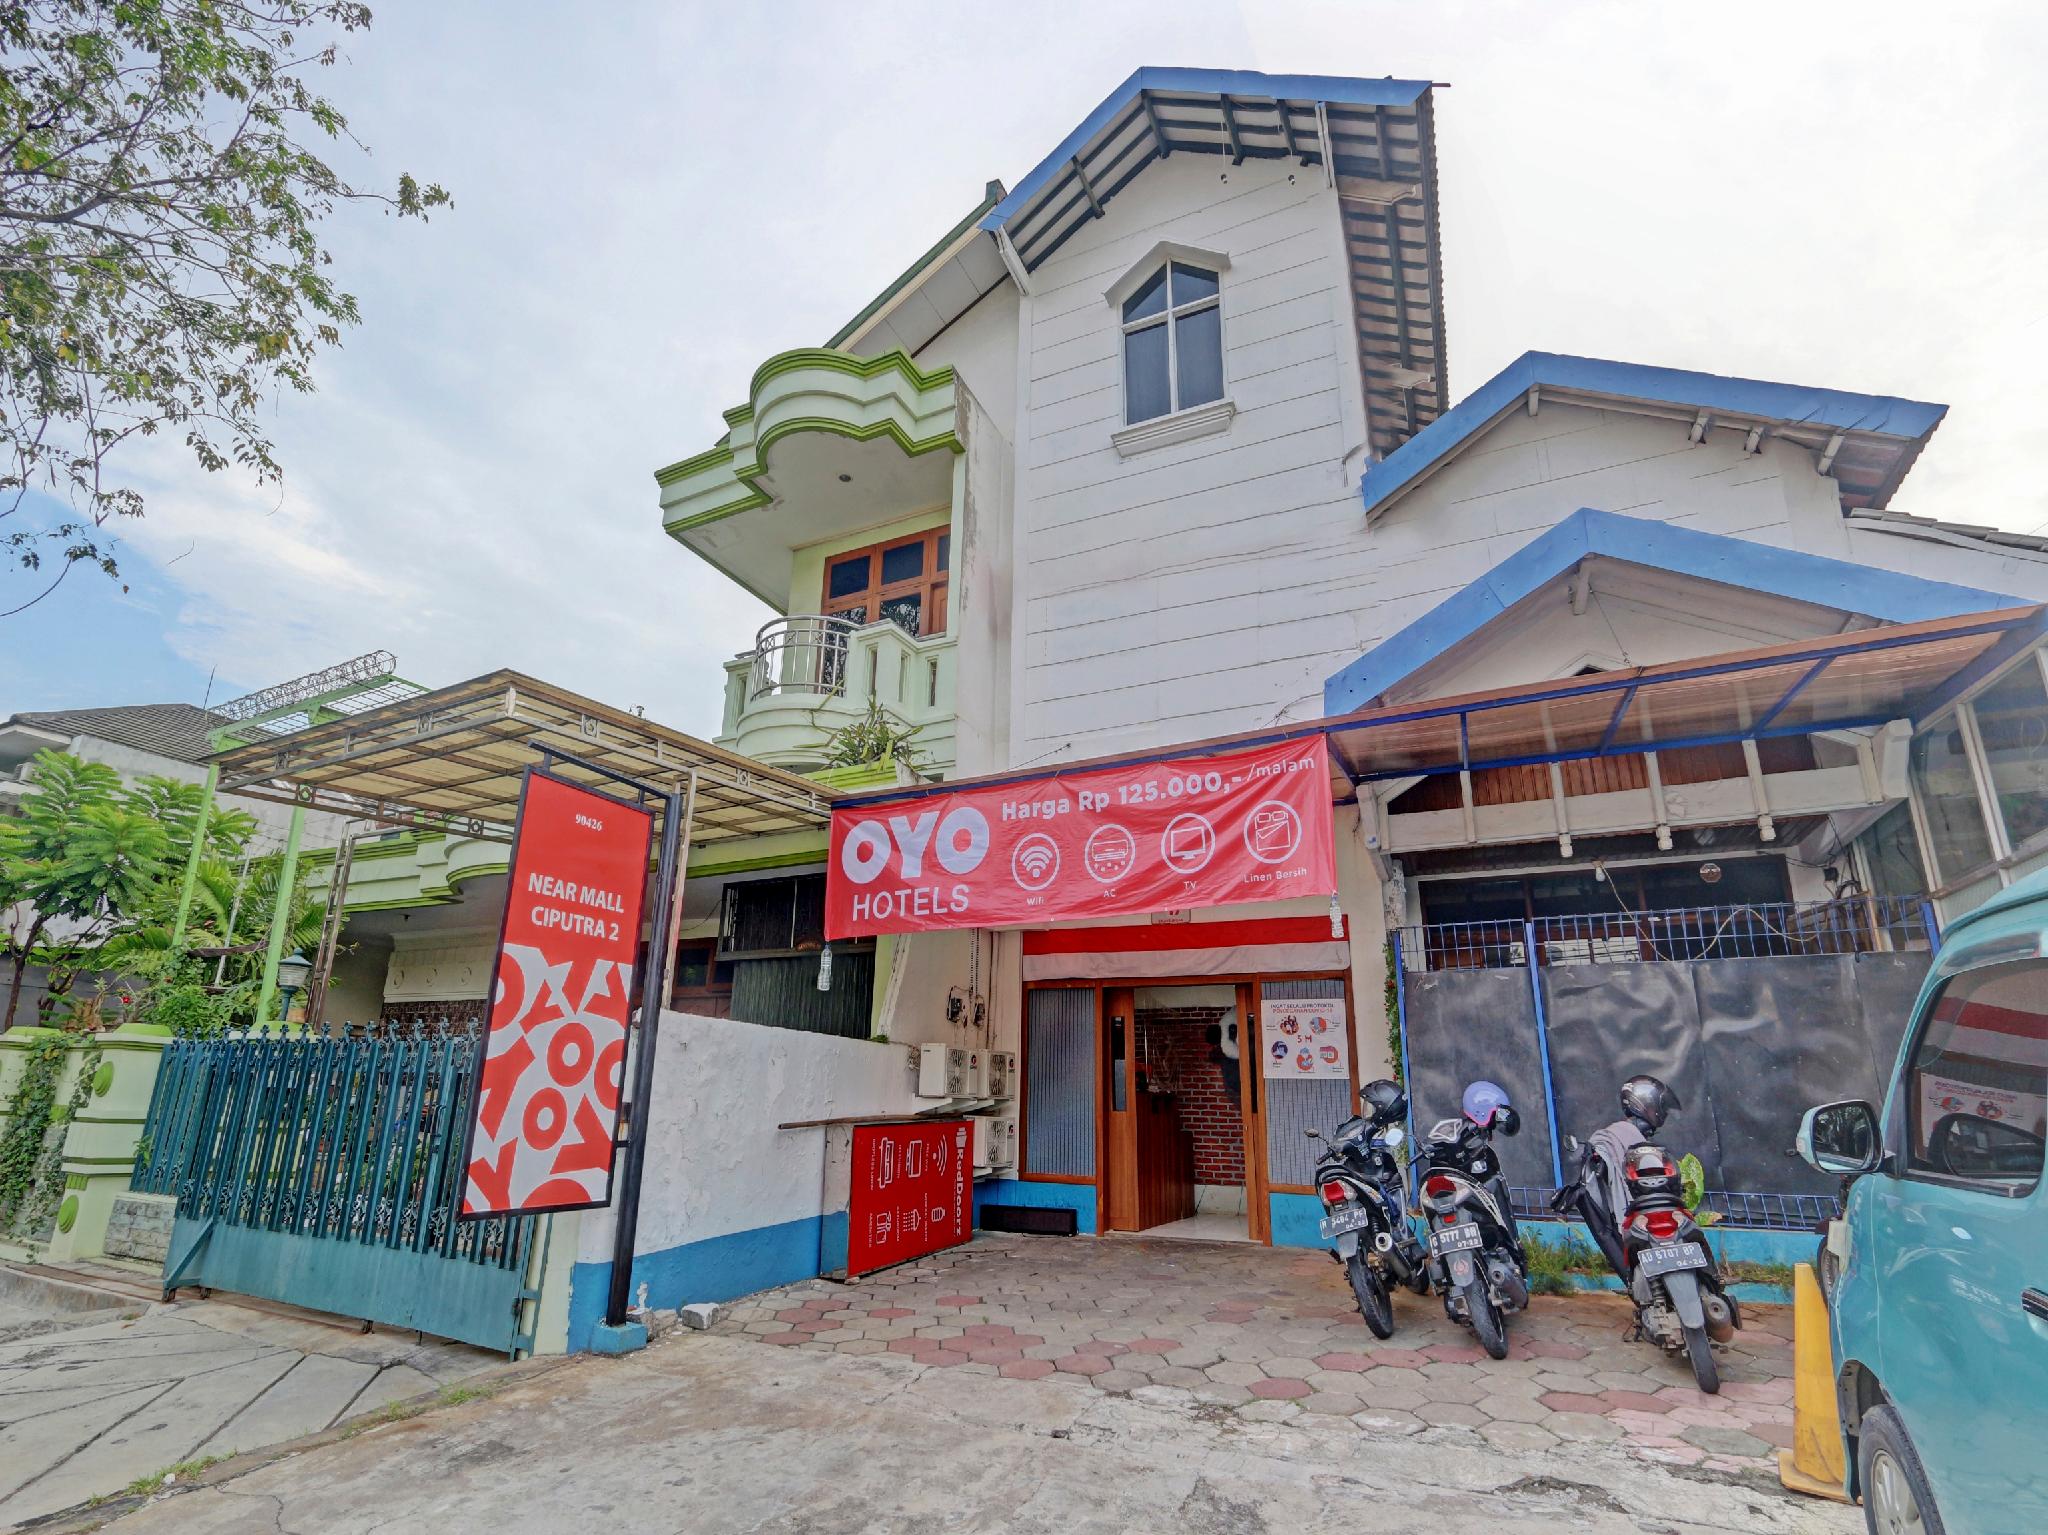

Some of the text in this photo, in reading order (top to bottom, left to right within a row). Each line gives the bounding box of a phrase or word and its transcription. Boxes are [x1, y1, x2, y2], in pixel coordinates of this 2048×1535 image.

[1002, 798, 1070, 821] Harga
[1078, 791, 1110, 813] Rp
[575, 813, 603, 832] 90426
[842, 807, 990, 885] OYO
[1183, 881, 1197, 890] TV
[1243, 867, 1307, 883] Linen Bersih
[528, 872, 625, 914] NEAR MALL
[852, 884, 971, 922] HOTELS
[1026, 896, 1045, 906] Wifi
[1103, 888, 1117, 898] AC
[531, 906, 620, 941] CIPUTRA 2
[955, 1148, 965, 1237] RedDoorz
[1440, 1230, 1459, 1243] 5777
